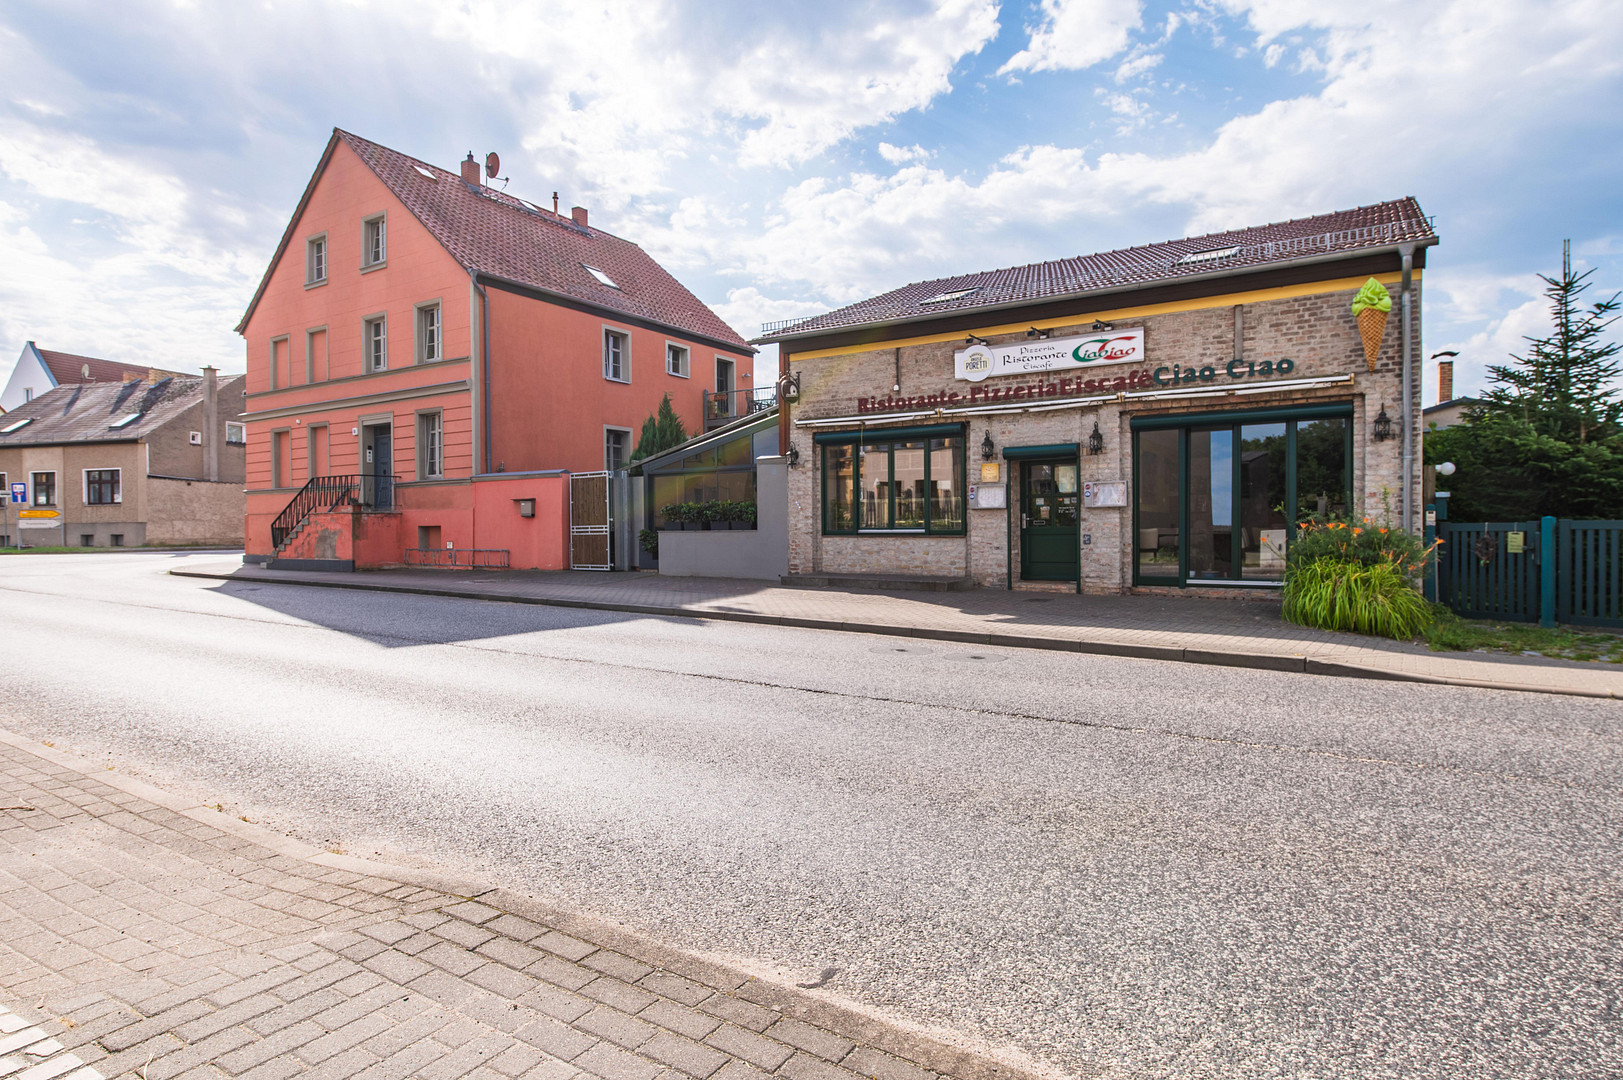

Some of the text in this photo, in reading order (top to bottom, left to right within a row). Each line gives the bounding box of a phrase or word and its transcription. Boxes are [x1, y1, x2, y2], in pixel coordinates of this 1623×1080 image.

[1020, 346, 1055, 355] Pizzeria
[1003, 351, 1068, 366] Ristorante
[965, 360, 988, 370] PORETTI
[858, 358, 1294, 413] Ristorante Pizzeria Eiscafé Ciao Ciao
